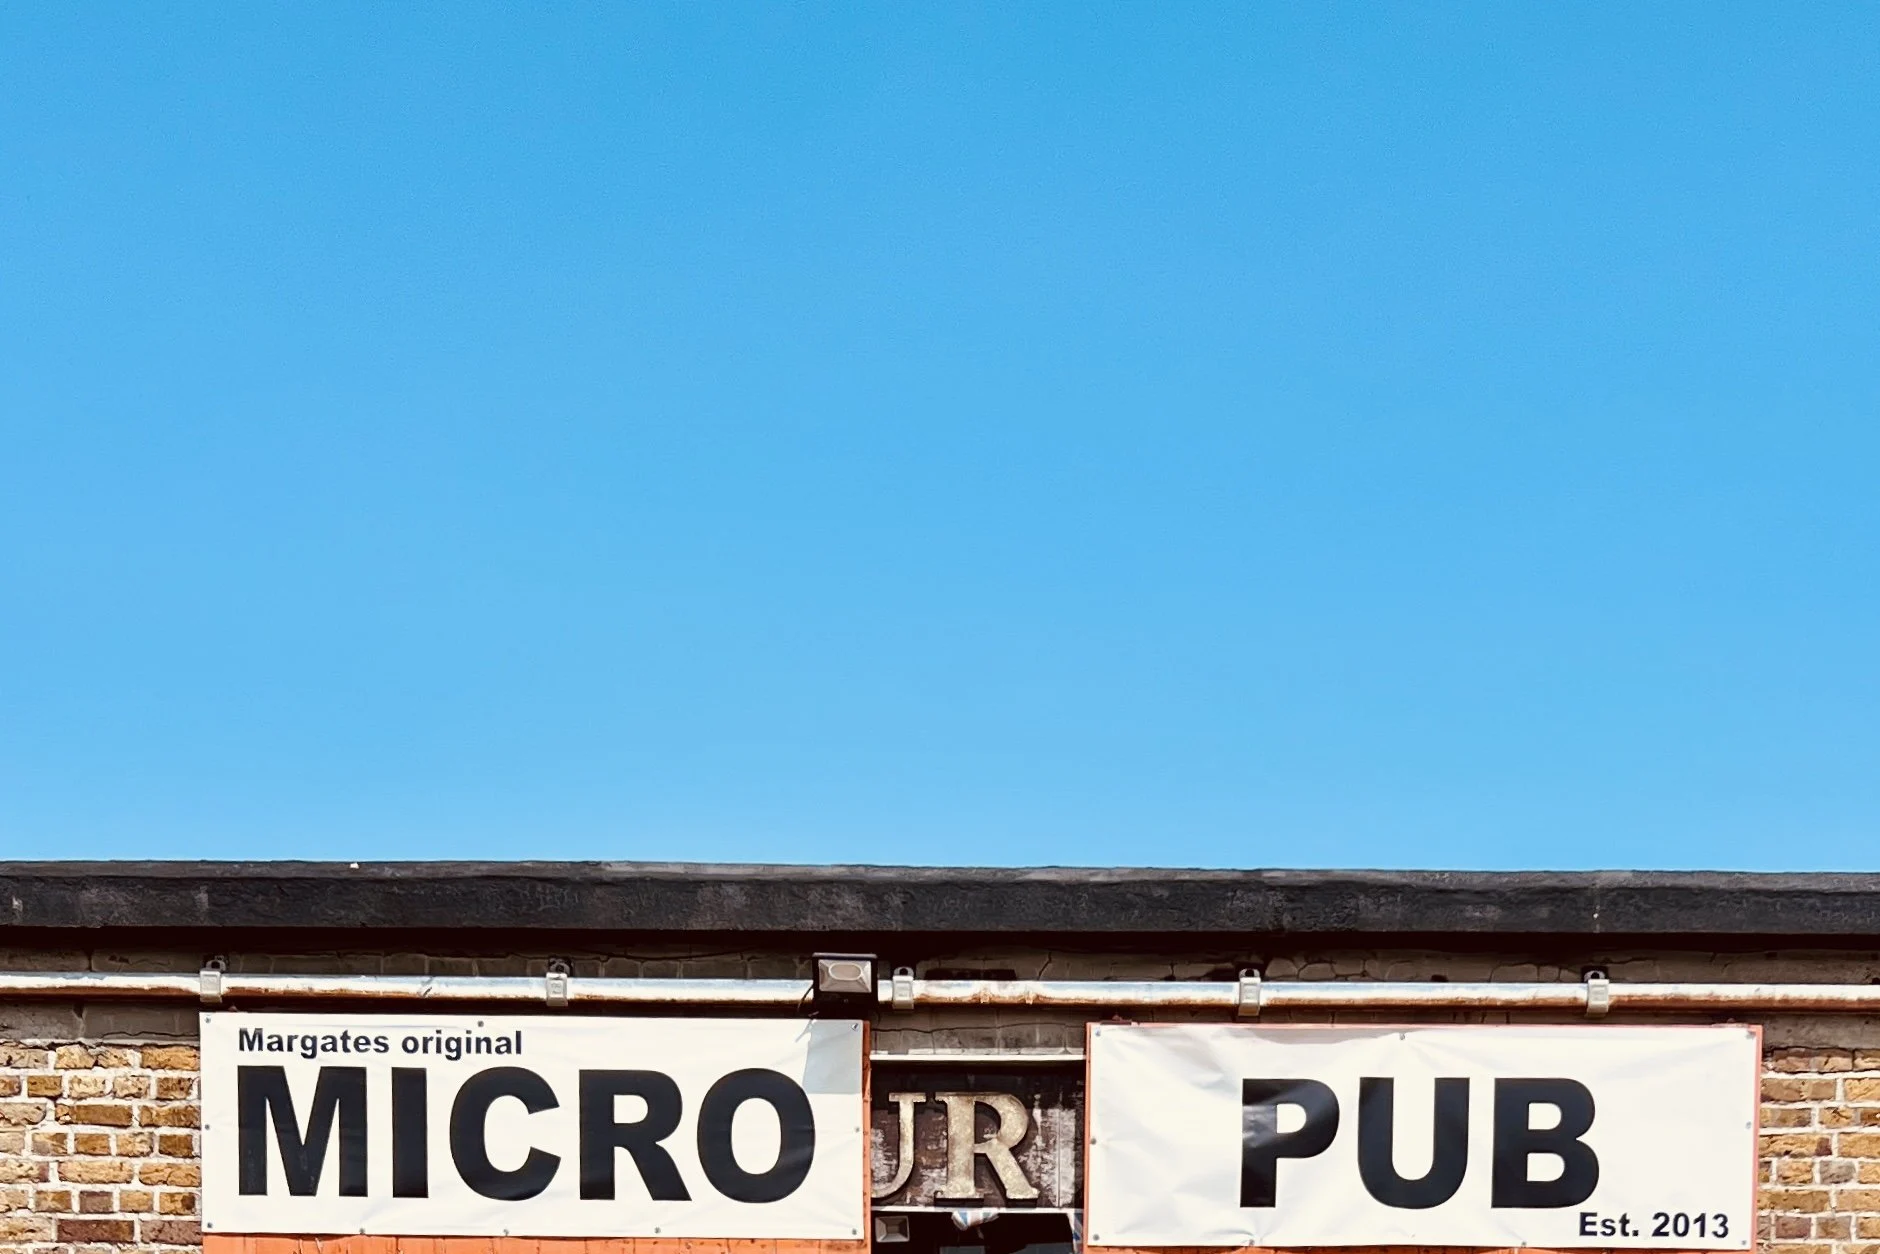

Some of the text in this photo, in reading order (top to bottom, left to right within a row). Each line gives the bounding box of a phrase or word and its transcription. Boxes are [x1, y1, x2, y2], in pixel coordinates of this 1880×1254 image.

[238, 1027, 522, 1062] Margates original
[237, 1064, 816, 1204] MICRO
[1239, 1076, 1600, 1210] PUB
[1579, 1211, 1729, 1239] Est. 2013
